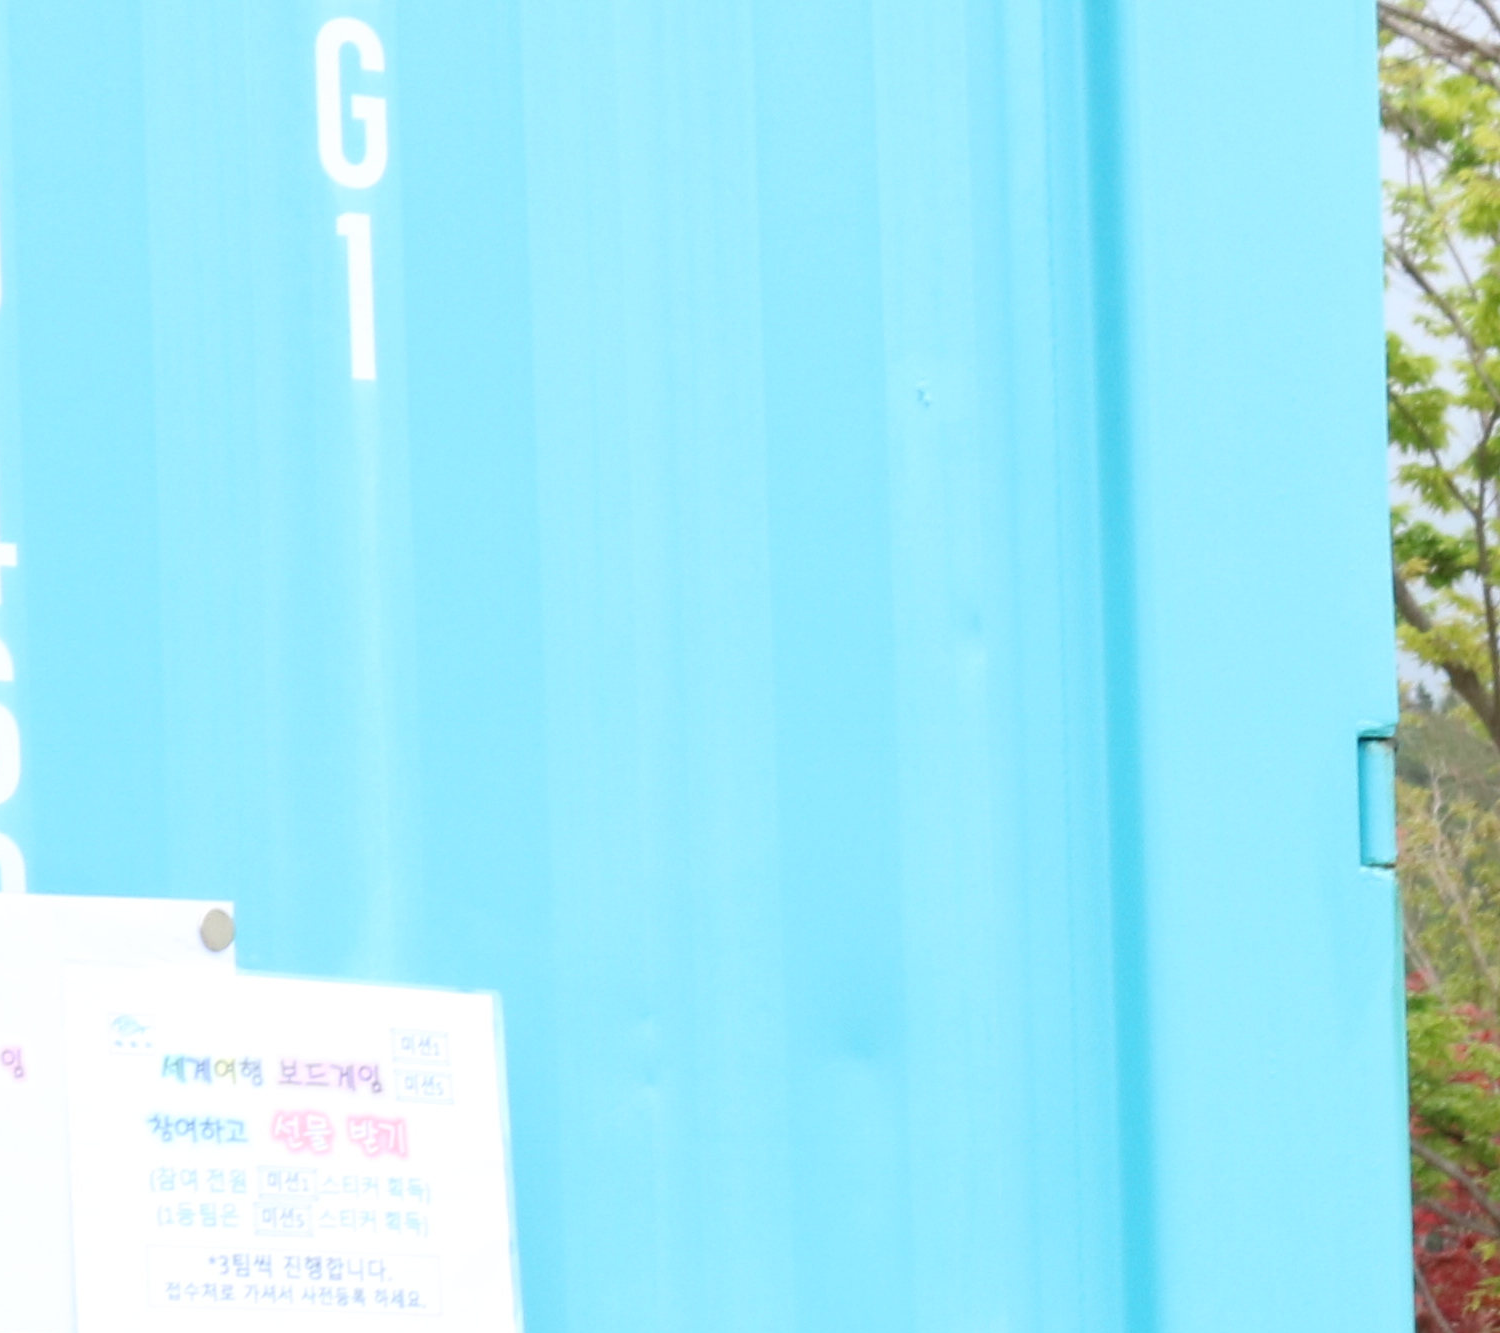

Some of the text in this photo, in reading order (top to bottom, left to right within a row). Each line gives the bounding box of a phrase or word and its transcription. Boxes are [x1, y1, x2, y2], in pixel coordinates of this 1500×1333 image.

[161, 1055, 383, 1094] 세계여행 보드게임
[272, 1113, 332, 1153] 선물
[348, 1117, 408, 1156] 받기
[207, 1169, 247, 1194] 전원
[322, 1175, 379, 1200] 스티커
[318, 1209, 376, 1233] 스티커
[283, 1255, 394, 1282] 진행합니다.
[245, 1284, 293, 1305] 가셔서
[302, 1285, 366, 1308] 사전등록
[375, 1288, 426, 1309] 하세요.
